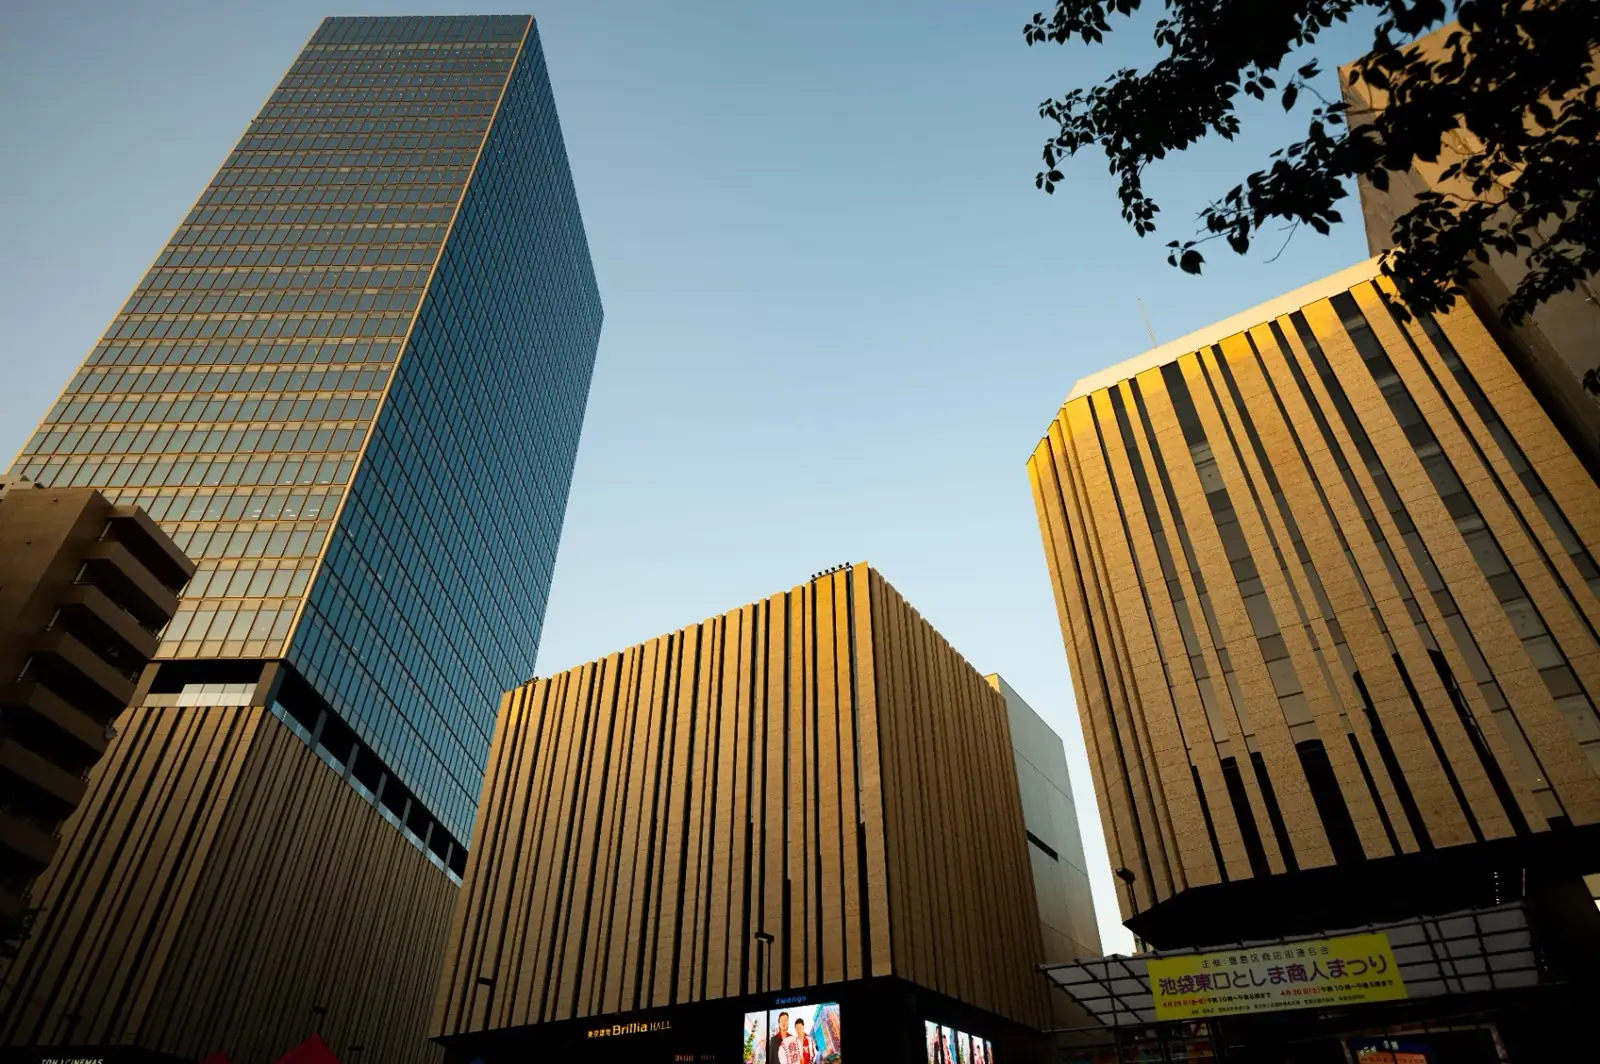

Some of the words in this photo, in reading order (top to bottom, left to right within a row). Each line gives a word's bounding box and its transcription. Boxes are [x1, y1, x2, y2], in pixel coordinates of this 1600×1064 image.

[1159, 954, 1387, 996] 池袋東口としま商人まつり
[775, 996, 807, 1005] dwango
[612, 1023, 648, 1036] Brillia
[650, 1020, 672, 1032] HALL
